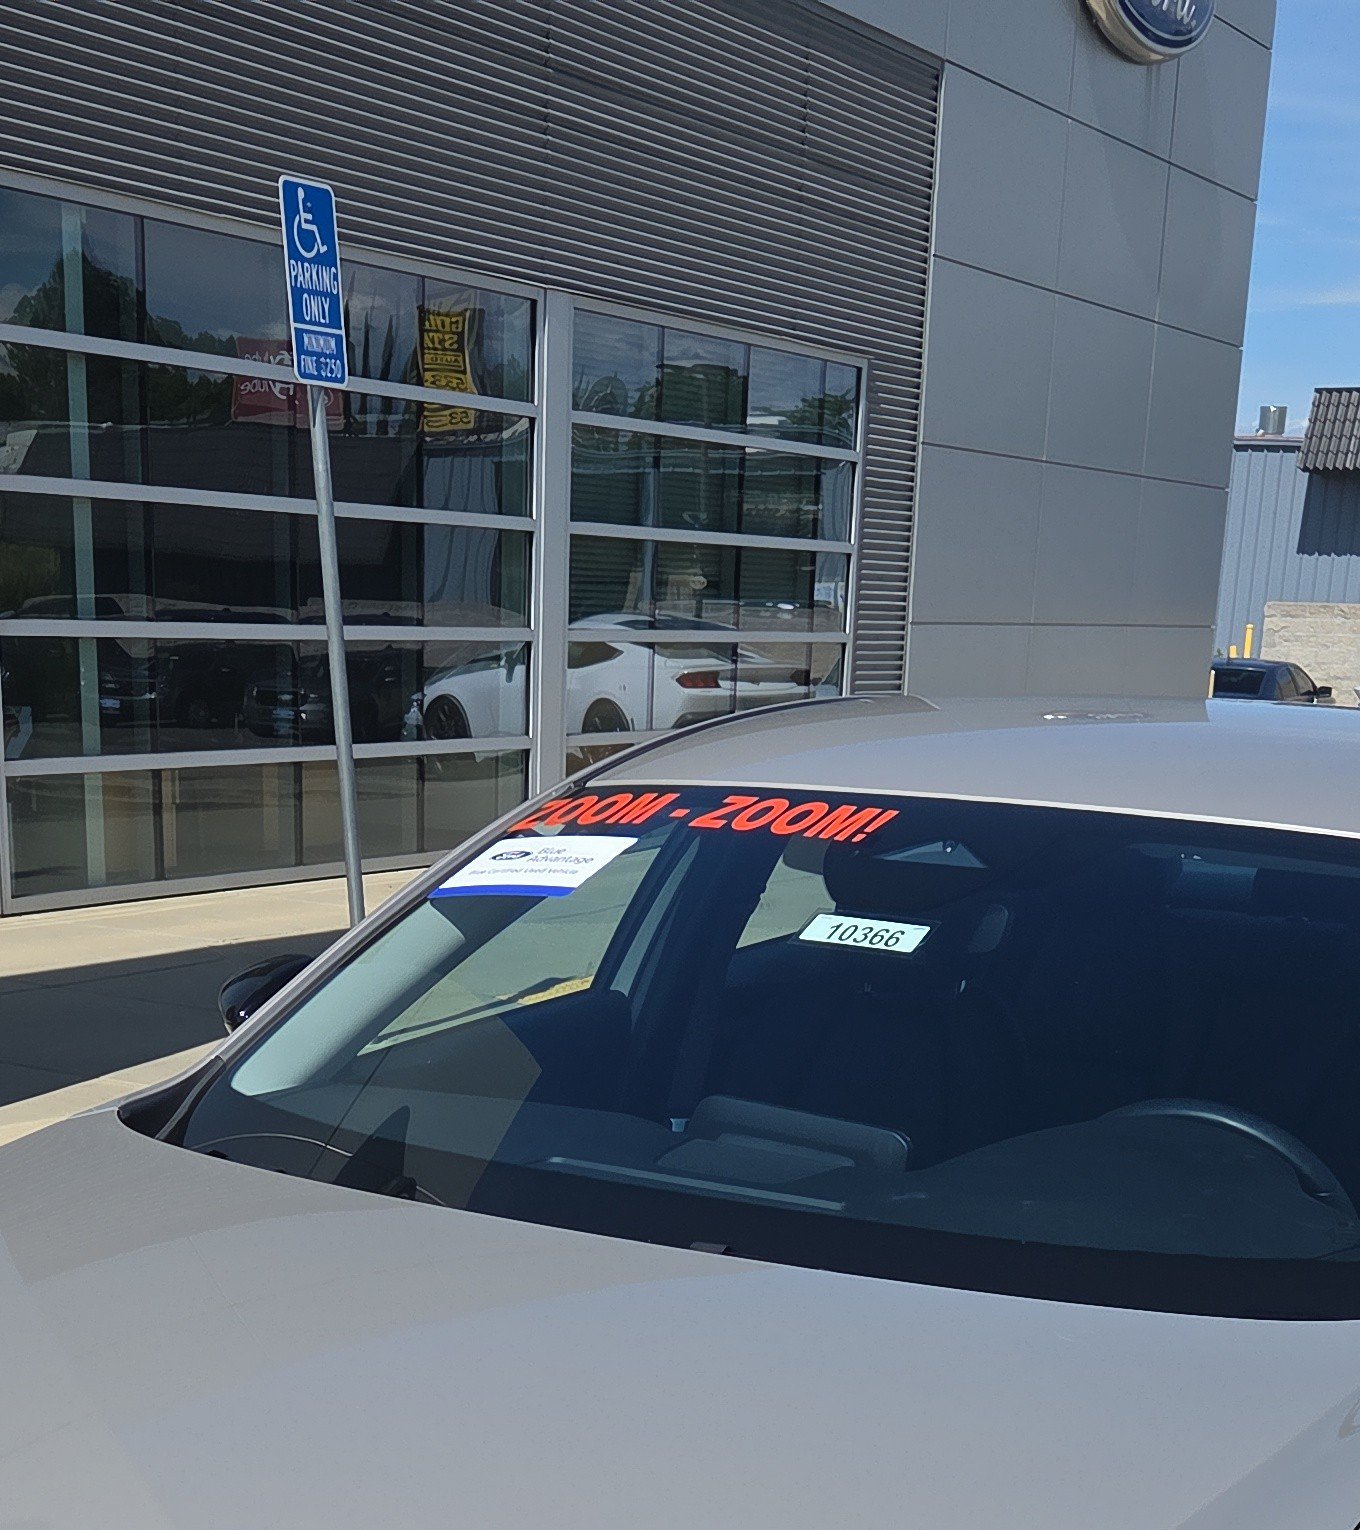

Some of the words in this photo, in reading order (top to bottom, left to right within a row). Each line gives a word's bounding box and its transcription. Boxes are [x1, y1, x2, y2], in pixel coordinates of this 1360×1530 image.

[290, 259, 338, 294] PARKING
[302, 293, 330, 324] ONLY
[300, 355, 317, 375] FINE
[320, 357, 342, 378] $250
[506, 792, 681, 834] ZOOM
[687, 795, 900, 843] ZOOM!
[526, 855, 594, 865] Advantage
[826, 922, 906, 948] 10366
